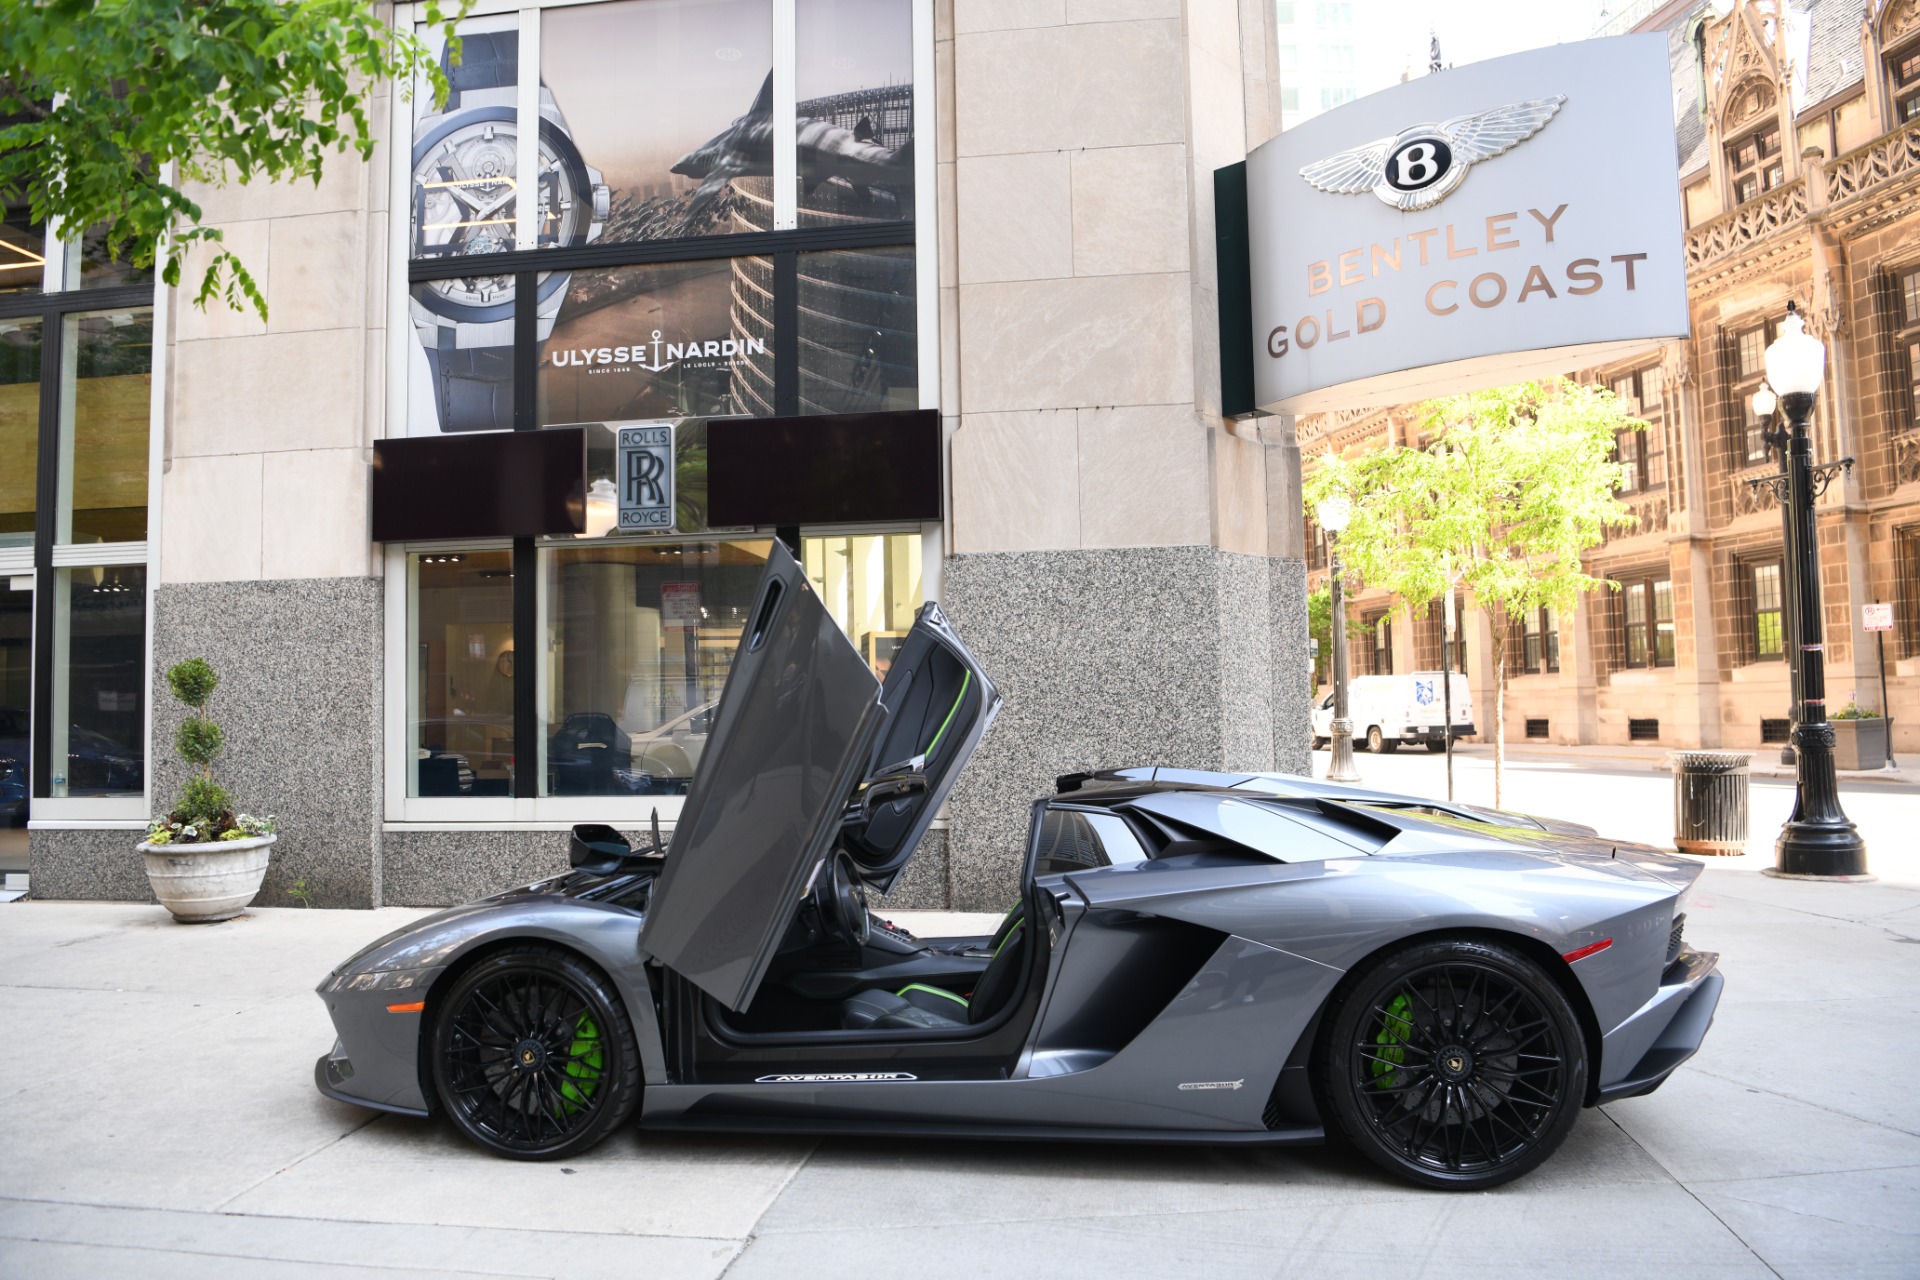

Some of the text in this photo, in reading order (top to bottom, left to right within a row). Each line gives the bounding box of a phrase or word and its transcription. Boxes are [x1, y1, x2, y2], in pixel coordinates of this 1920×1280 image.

[1395, 142, 1437, 186] B
[1307, 204, 1568, 297] BENTLEY
[1267, 252, 1648, 359] GOLD COAST
[552, 338, 764, 367] ULYSSE NARDIN
[622, 431, 667, 445] ROLLS
[622, 511, 667, 524] ROYCE
